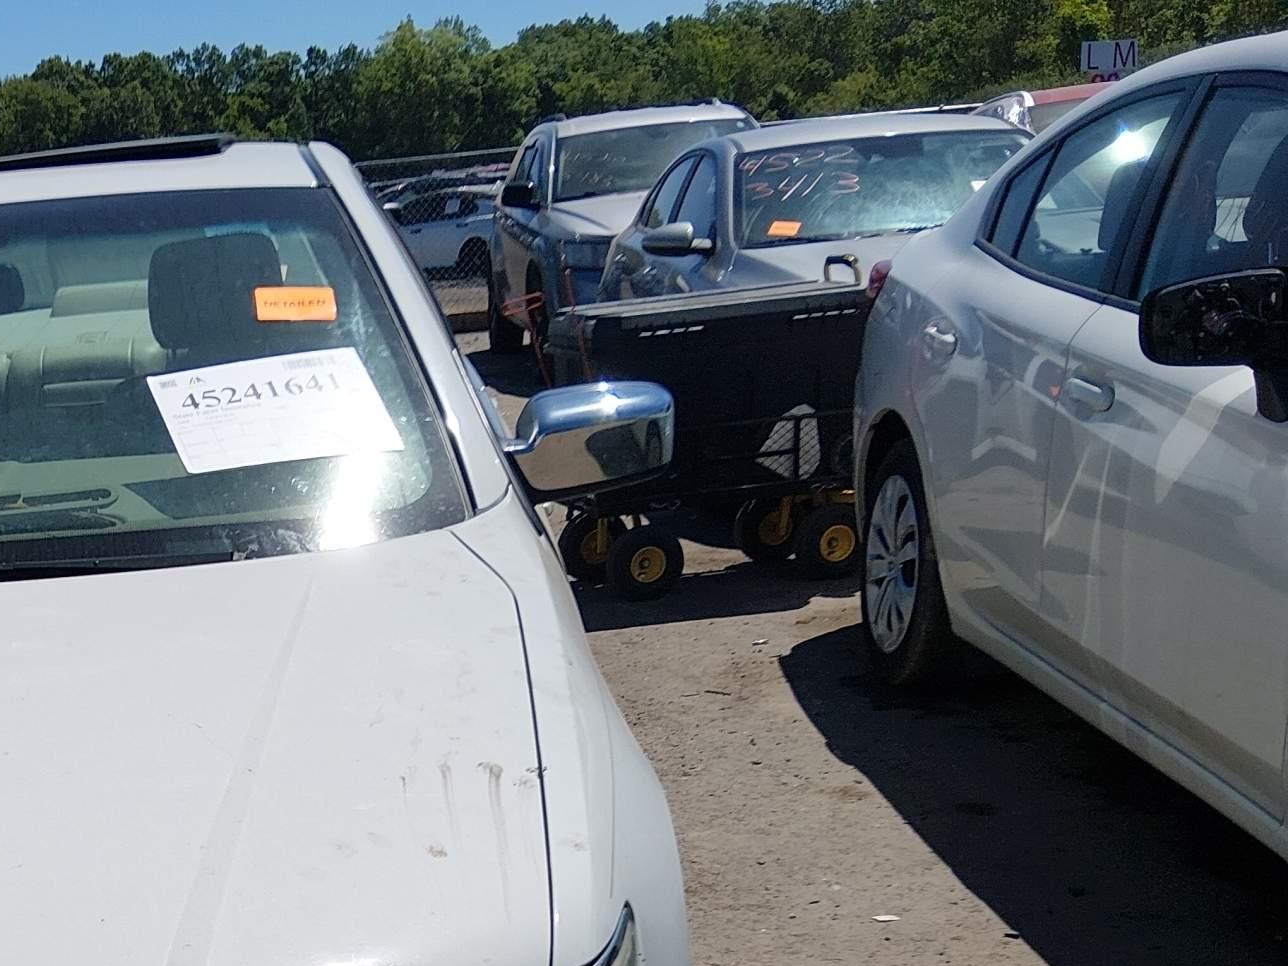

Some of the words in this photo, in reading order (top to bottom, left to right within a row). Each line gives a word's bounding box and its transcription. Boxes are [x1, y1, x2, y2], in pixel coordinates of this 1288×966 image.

[1088, 44, 1099, 69] L
[1113, 41, 1136, 68] M
[738, 146, 858, 177] 4522
[746, 172, 860, 201] 3413
[182, 372, 342, 410] 45241641
